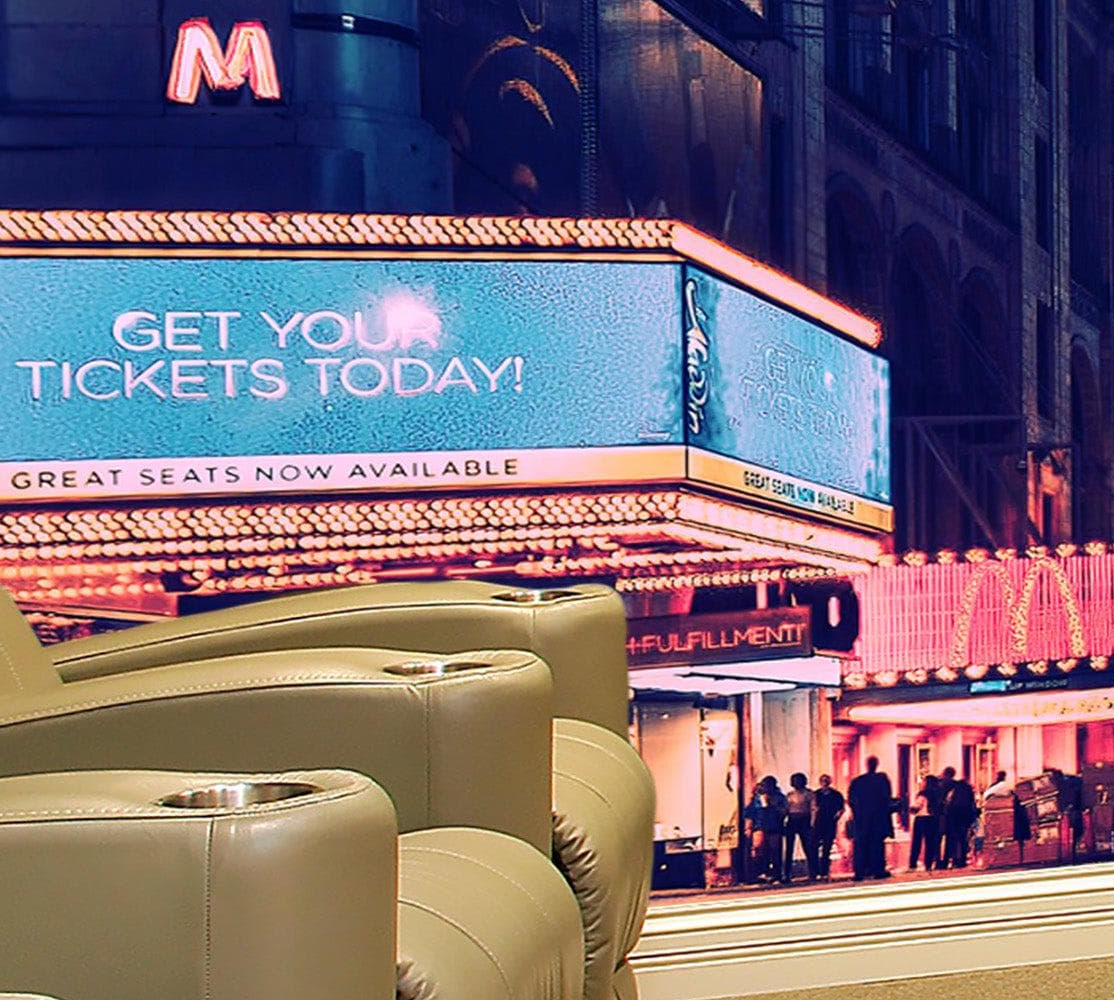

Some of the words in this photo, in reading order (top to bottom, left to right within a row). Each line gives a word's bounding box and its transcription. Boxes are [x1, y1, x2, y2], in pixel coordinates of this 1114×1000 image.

[112, 310, 242, 351] GET
[259, 307, 442, 351] YOUR
[15, 358, 290, 401] TICKETS
[303, 355, 525, 398] TODAY!
[10, 469, 122, 491] GREAT
[139, 466, 241, 487] SEATS
[255, 464, 333, 482] NOW
[347, 458, 519, 480] AVAILABLE
